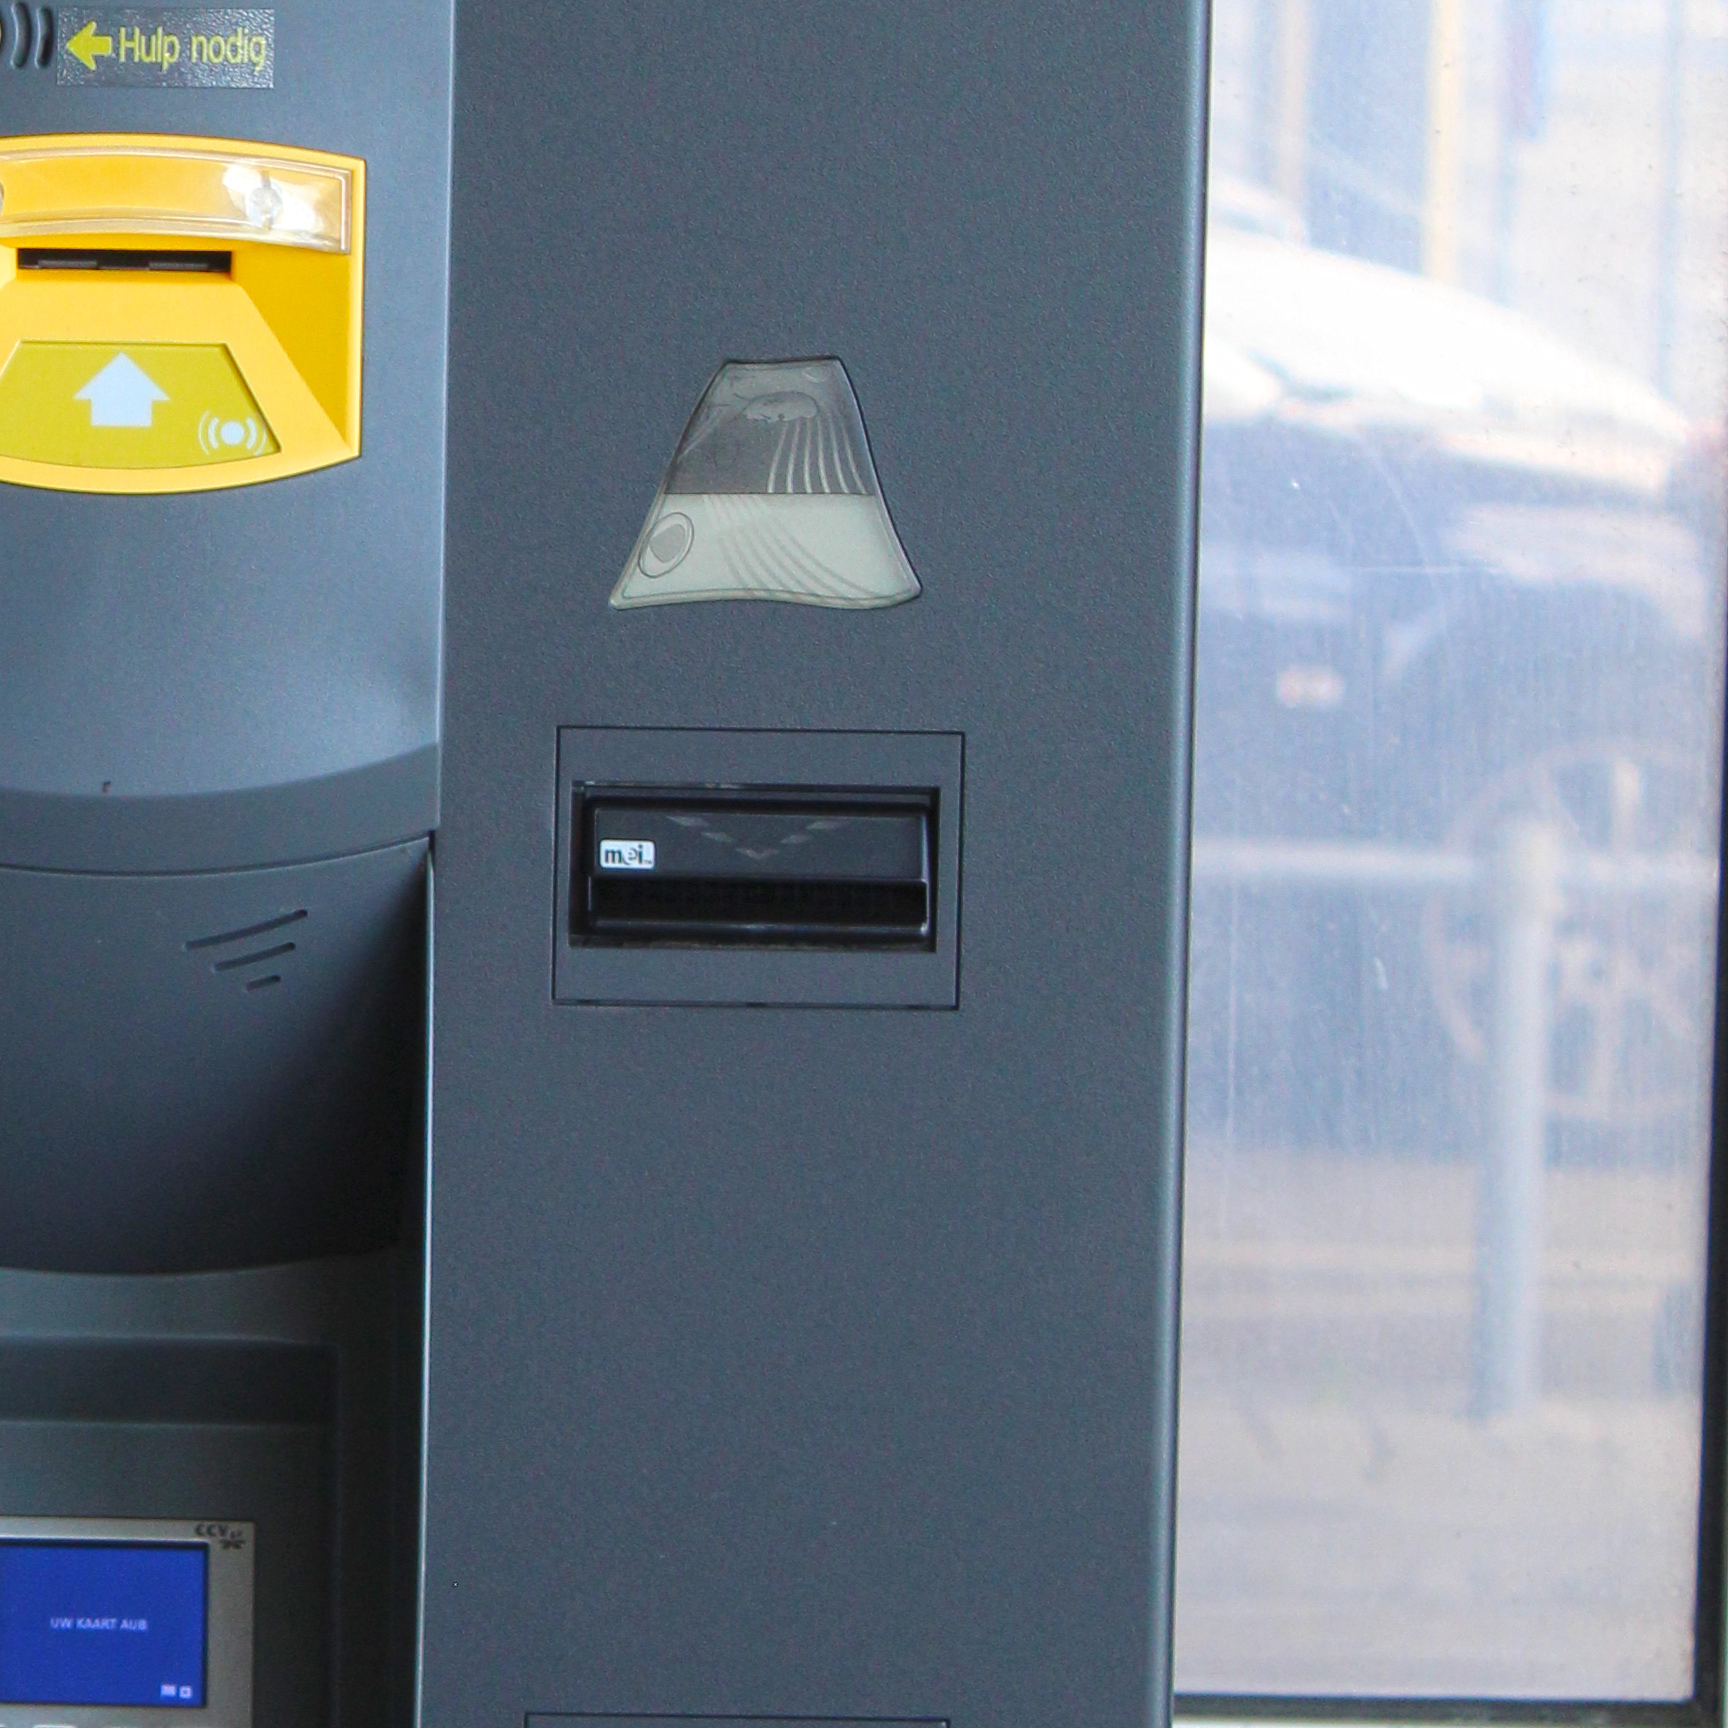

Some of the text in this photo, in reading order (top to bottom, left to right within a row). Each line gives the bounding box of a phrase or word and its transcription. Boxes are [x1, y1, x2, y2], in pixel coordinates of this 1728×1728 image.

[119, 26, 266, 73] Hulp nodig
[605, 844, 643, 865] mei
[195, 1524, 228, 1538] CCV
[50, 1618, 148, 1631] UW KAART AUB
